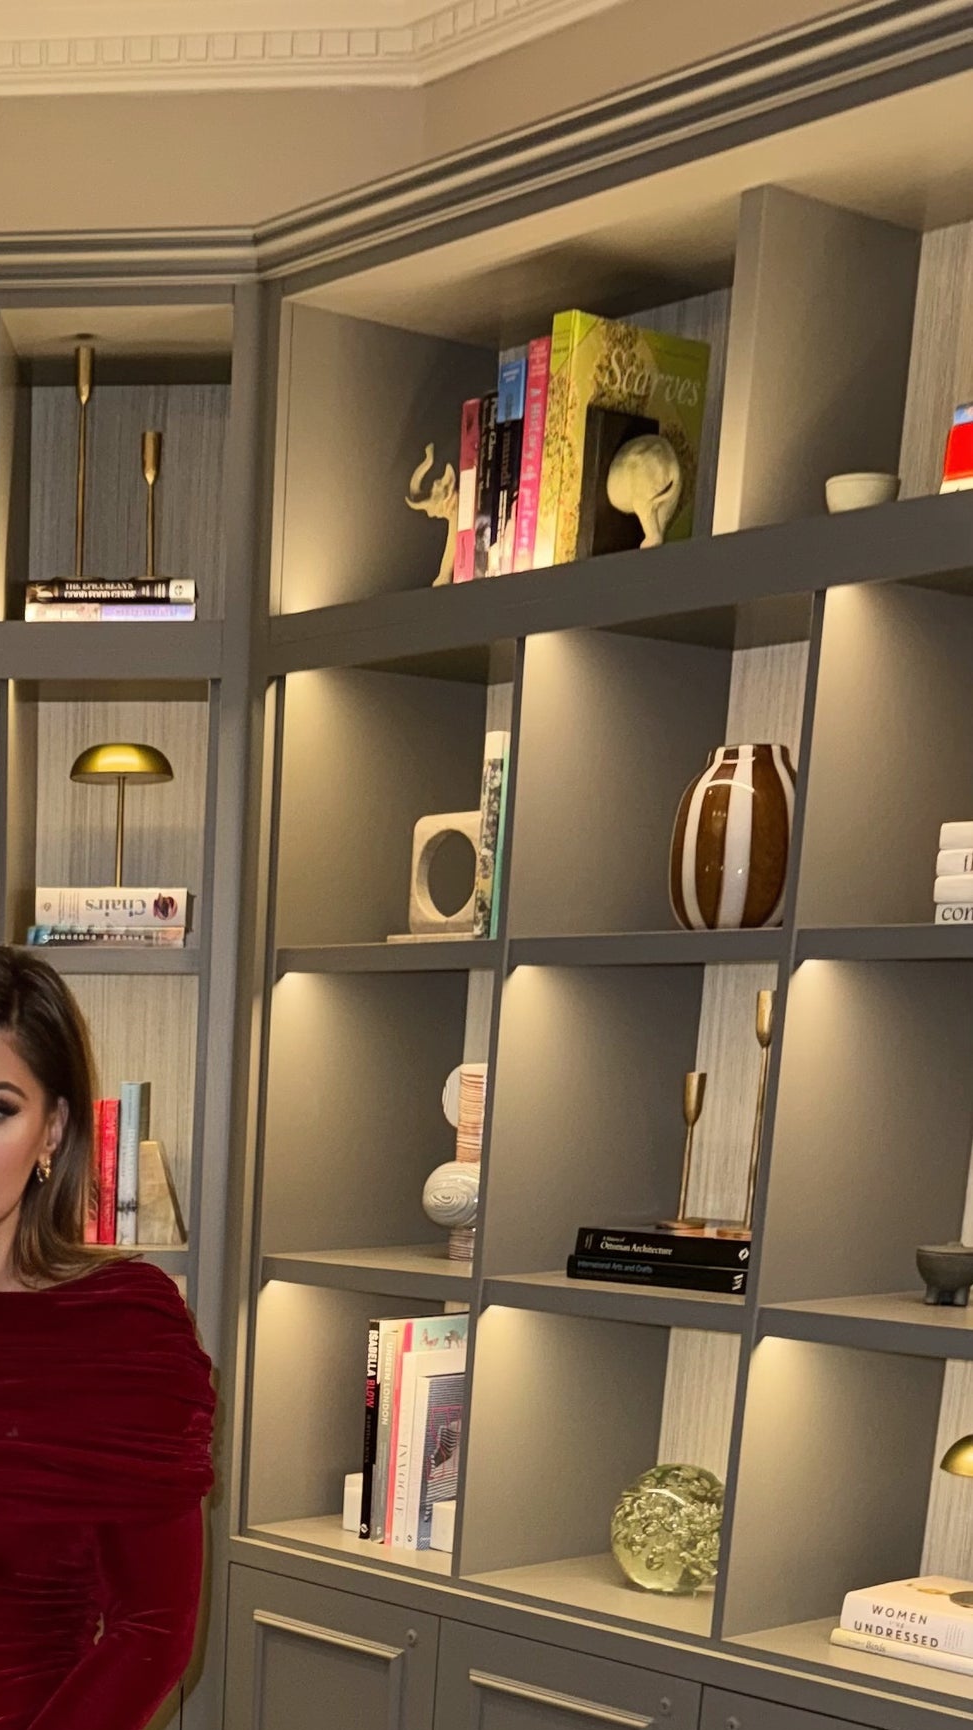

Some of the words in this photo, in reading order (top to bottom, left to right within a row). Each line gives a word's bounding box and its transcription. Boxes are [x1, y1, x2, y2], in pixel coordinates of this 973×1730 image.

[601, 349, 701, 407] Scarves
[525, 402, 542, 460] History
[85, 899, 147, 917] Chairs
[600, 1241, 630, 1252] Ottoman
[631, 1243, 673, 1256] Architecture
[577, 1259, 611, 1269] International
[612, 1261, 622, 1271] Arts
[624, 1263, 635, 1272] and
[635, 1263, 653, 1274] Crafts
[367, 1330, 379, 1377] ISABELLA
[384, 1342, 394, 1380] UNSEEN
[365, 1380, 376, 1408] BLOW
[381, 1383, 392, 1425] LONDON
[872, 1604, 928, 1625] WOMEN
[854, 1620, 939, 1648] UNDRESSED
